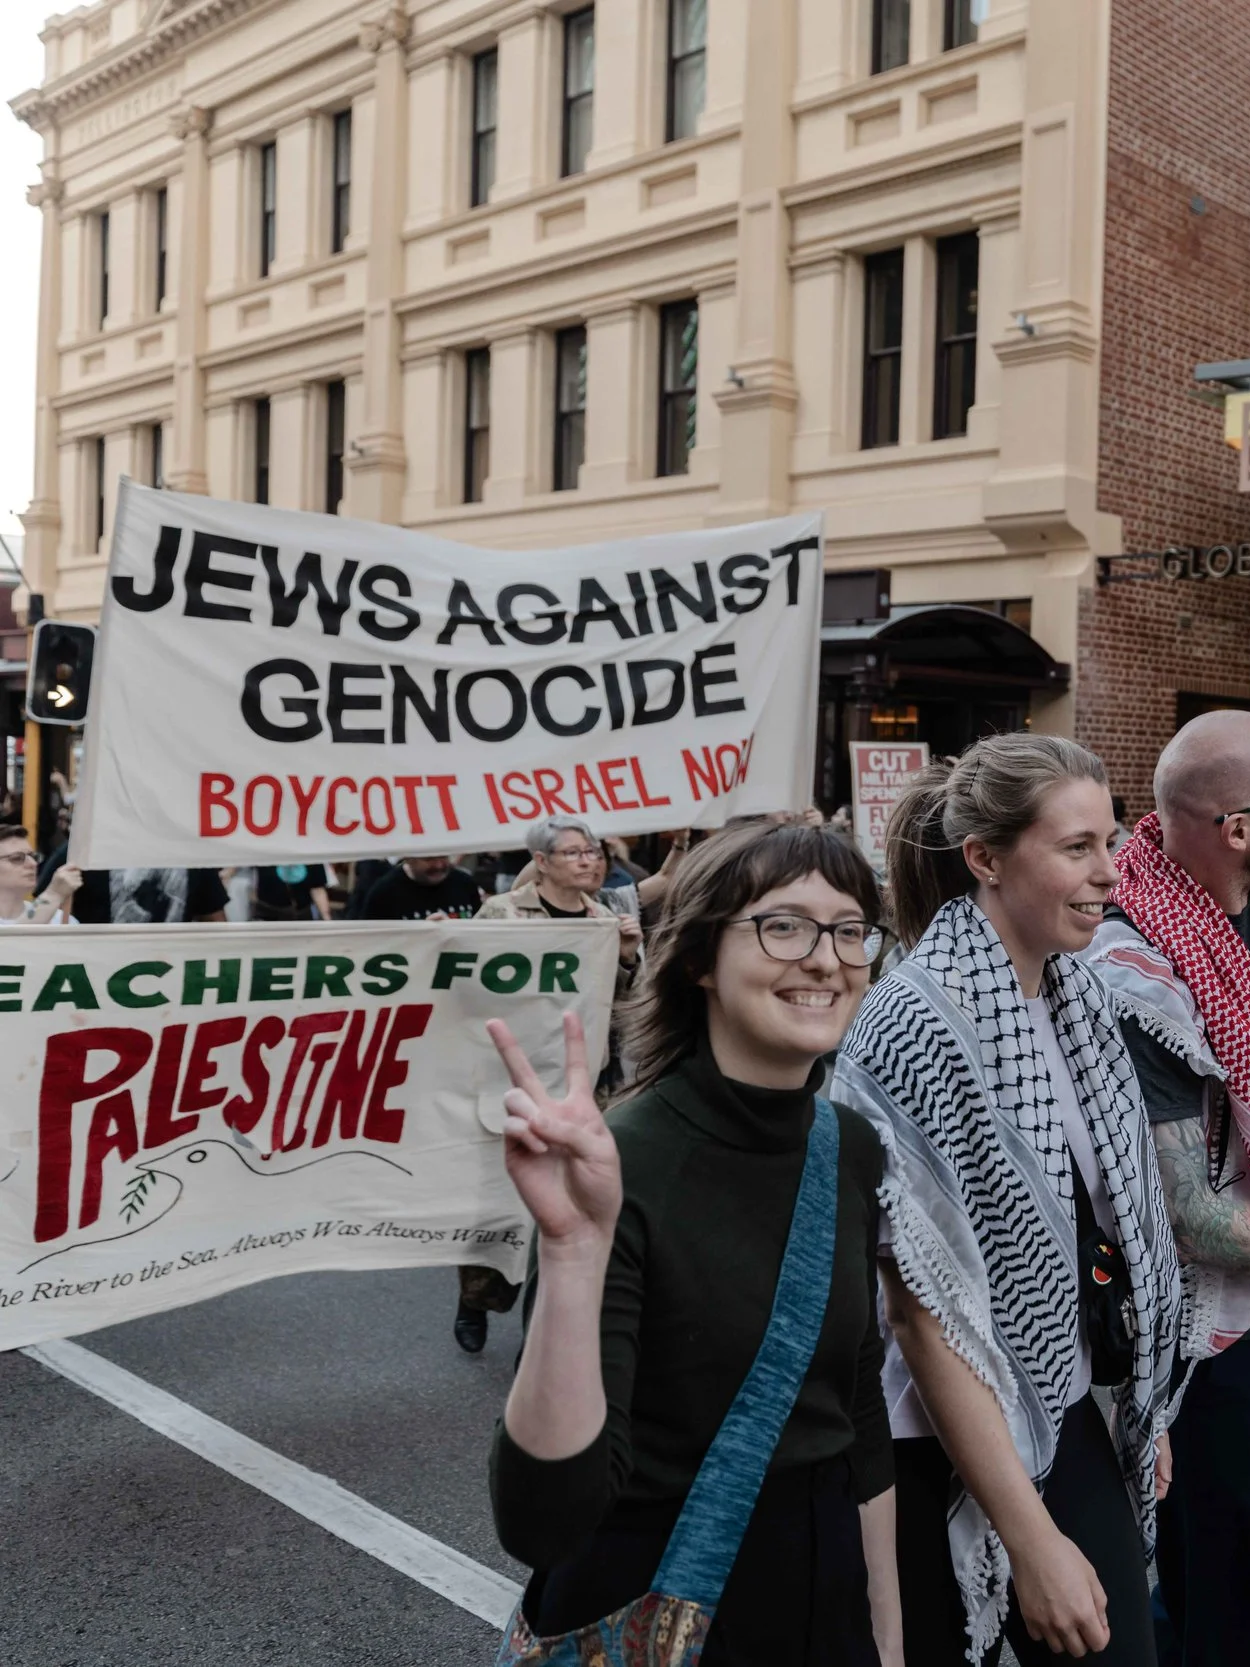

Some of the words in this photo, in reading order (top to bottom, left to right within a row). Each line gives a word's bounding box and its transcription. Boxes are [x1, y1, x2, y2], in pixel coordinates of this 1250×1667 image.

[111, 525, 421, 642] JEWS
[436, 536, 819, 647] AGAINST
[240, 642, 746, 744] GENOCIDE
[200, 771, 461, 838] BOYCOTT
[483, 755, 672, 824] ISRAEL
[868, 750, 911, 772] CUT
[0, 953, 409, 1013] EACHERS
[431, 951, 580, 994] FOR
[33, 1003, 434, 1243] PALESTINE
[0, 1288, 24, 1307] he
[29, 1279, 107, 1302] River
[111, 1273, 134, 1289] to
[140, 1260, 174, 1282] the
[223, 1227, 308, 1258] Always
[312, 1219, 364, 1239] Was
[362, 1221, 447, 1244] Always
[452, 1227, 498, 1244] Will
[500, 1229, 525, 1250] Be
